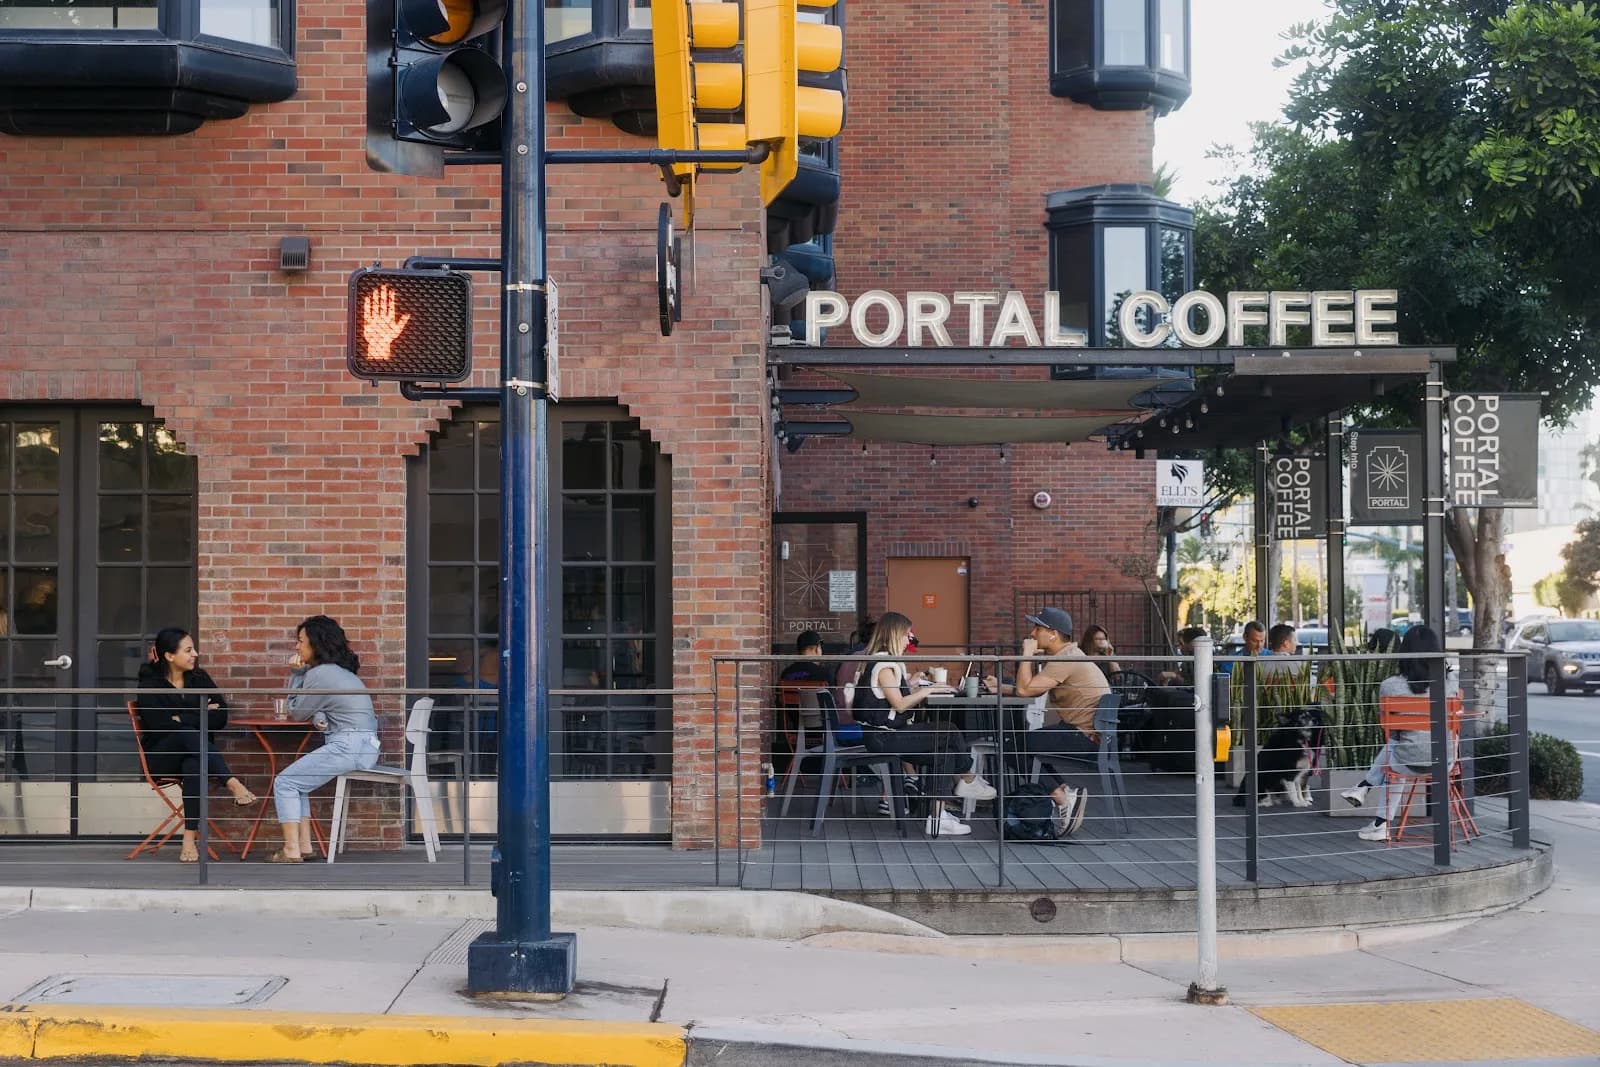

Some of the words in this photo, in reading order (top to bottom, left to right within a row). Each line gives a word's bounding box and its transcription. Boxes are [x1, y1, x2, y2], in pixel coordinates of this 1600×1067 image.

[805, 290, 1088, 347] PORTAL
[1119, 290, 1399, 347] COFFEE
[1349, 431, 1359, 452] Step
[1350, 452, 1359, 469] Into
[1453, 395, 1476, 505] COFFEE
[1477, 395, 1500, 505] PORTAL
[1161, 485, 1198, 496] ELLI'S
[1276, 458, 1293, 538] COFFEE
[1293, 458, 1311, 538] PORTAL
[1371, 499, 1405, 507] PORTAL
[789, 620, 834, 631] PORTAL
